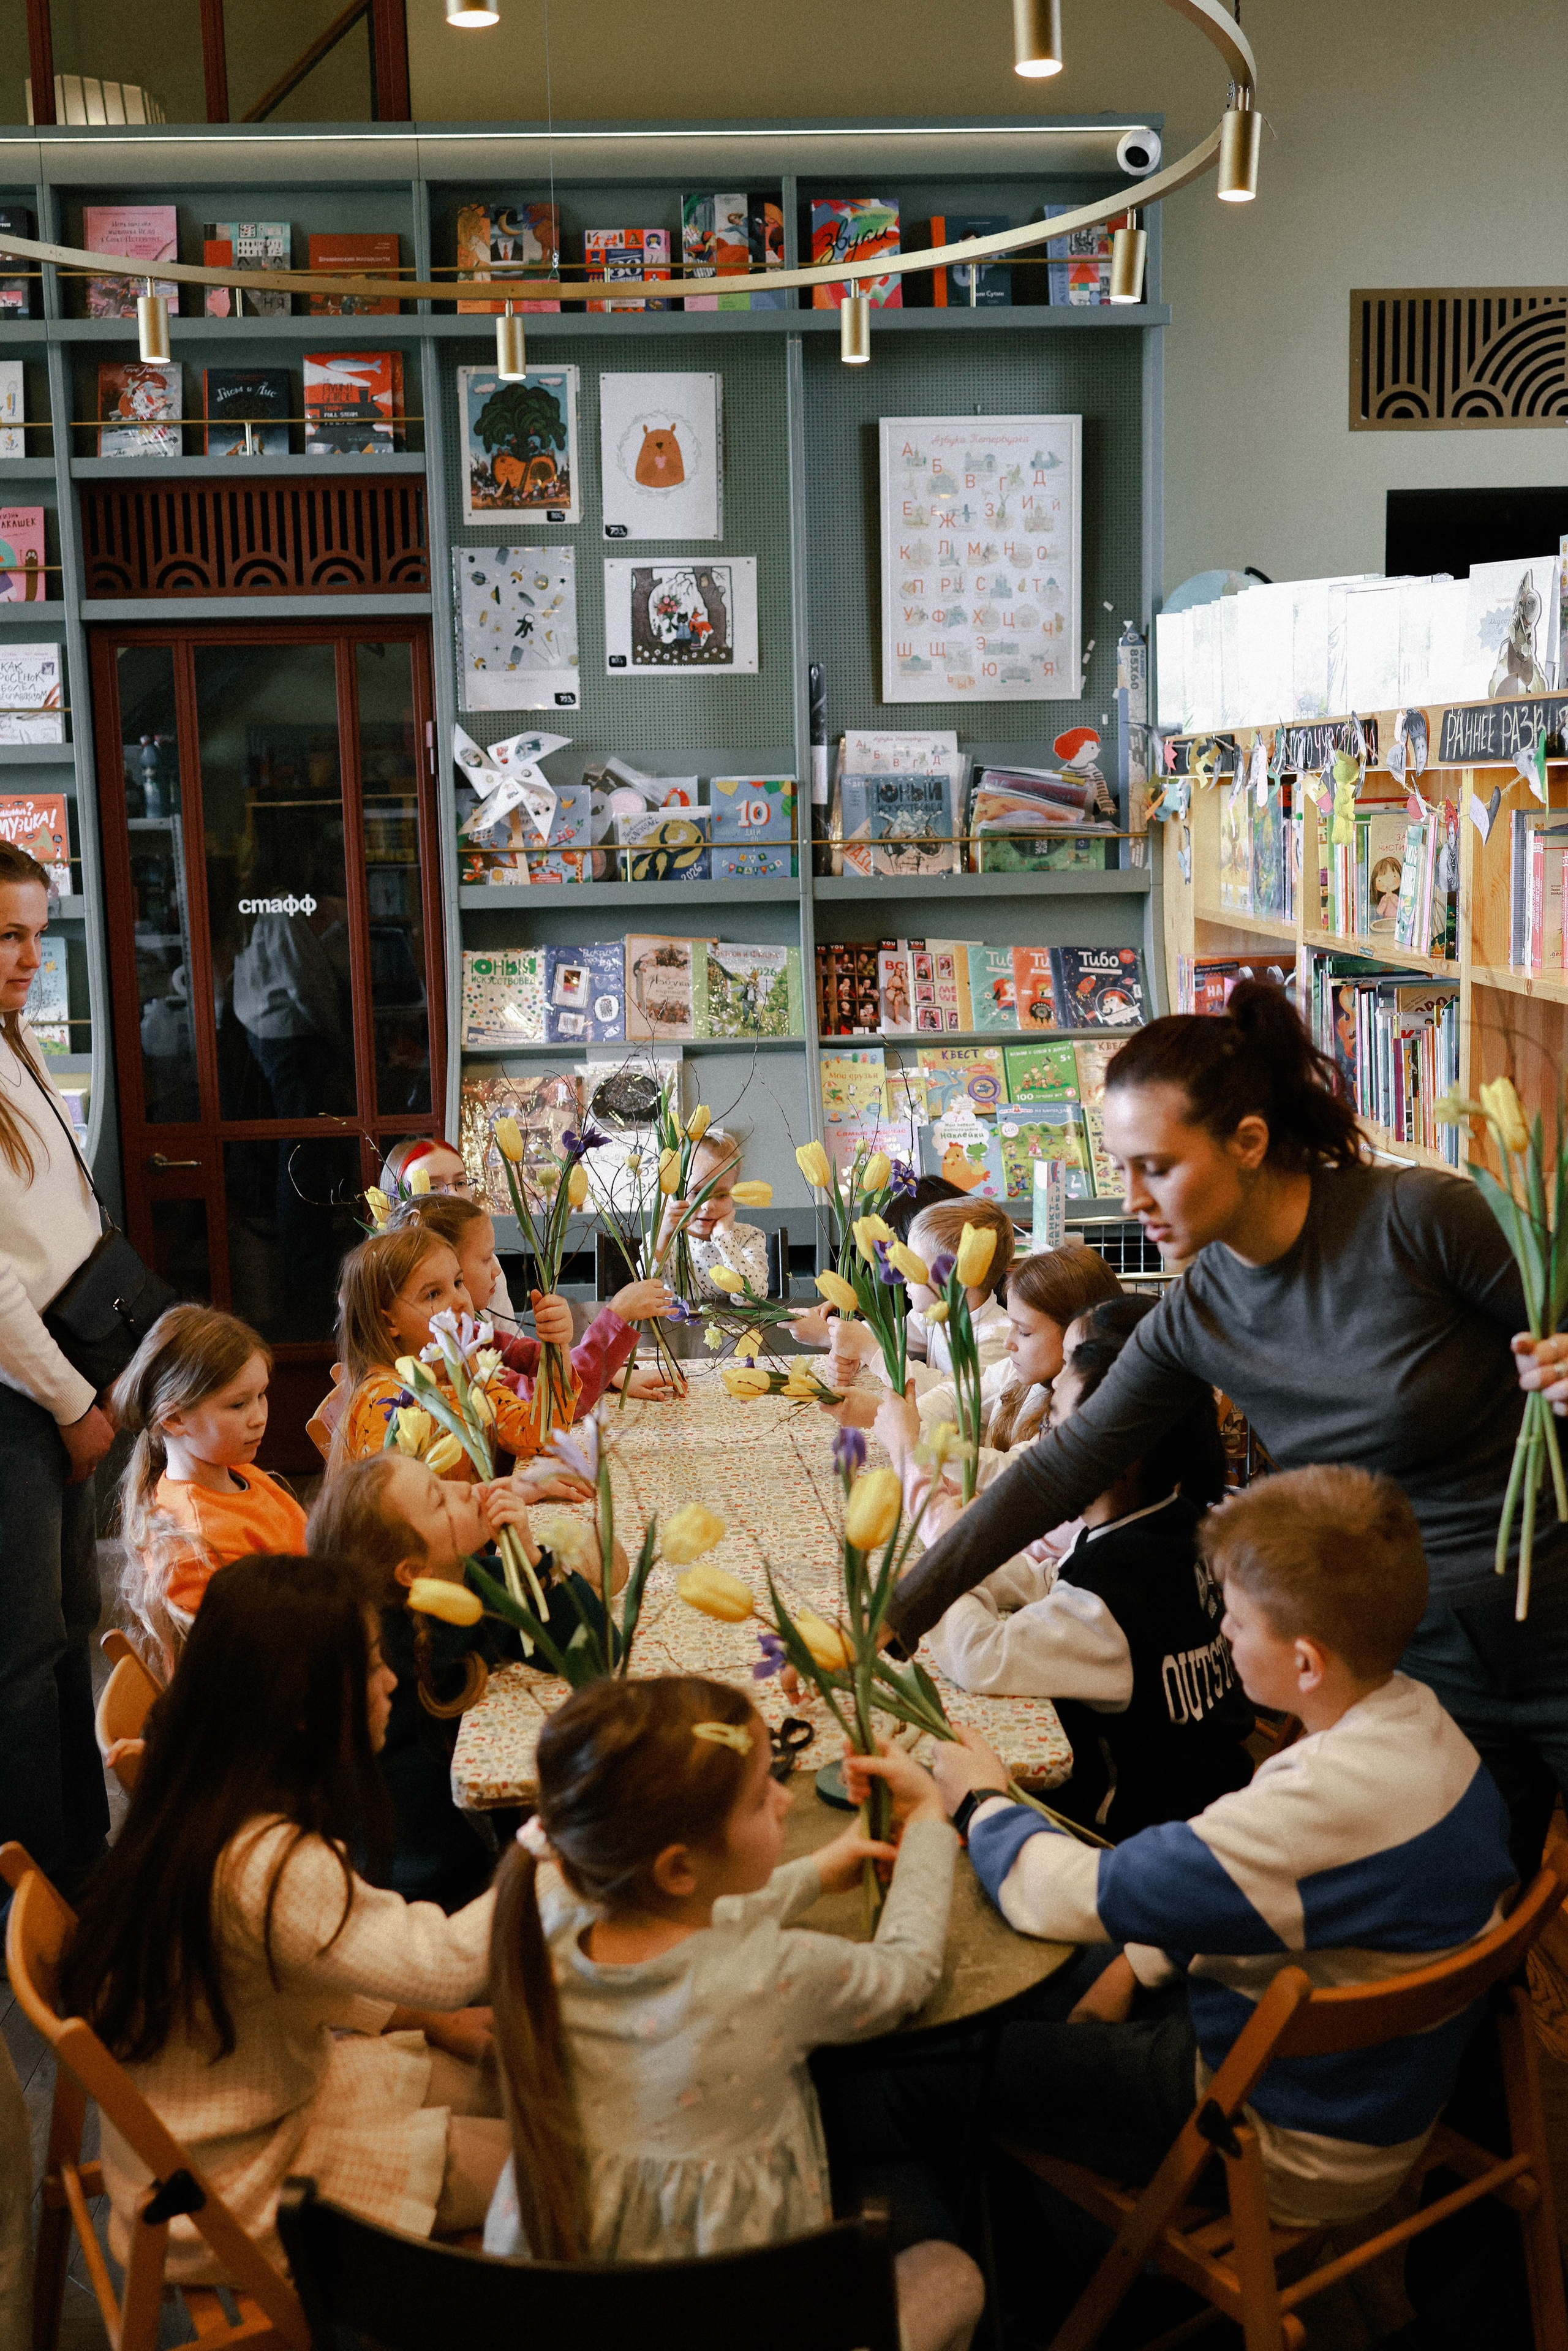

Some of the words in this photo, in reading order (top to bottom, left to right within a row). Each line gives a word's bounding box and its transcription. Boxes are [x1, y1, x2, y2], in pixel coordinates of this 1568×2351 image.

[902, 442, 913, 456] А
[933, 459, 942, 473] Б
[966, 475, 975, 488] В
[1000, 477, 1006, 490] Г
[1034, 470, 1046, 486] Д
[903, 502, 912, 515] Е
[1023, 497, 1033, 508] И
[986, 504, 993, 517] З
[1, 518, 36, 529] АКАШЕК
[940, 514, 956, 527] Ж
[900, 545, 910, 559] К
[938, 541, 949, 554] Л
[968, 542, 980, 555] М
[1005, 542, 1014, 554] Н
[1038, 547, 1046, 560] О
[913, 579, 923, 593] П
[941, 579, 950, 592] Р
[977, 577, 986, 591] С
[1033, 579, 1041, 592] Т
[903, 606, 913, 620] У
[932, 611, 945, 622] Ф
[973, 609, 983, 623] Х
[1003, 613, 1014, 627] Ц
[1043, 624, 1052, 635] Ч
[897, 643, 911, 657] Ш
[930, 643, 945, 657] Щ
[977, 637, 986, 650] Э
[983, 663, 997, 676] Ю
[1044, 663, 1054, 675] Я
[1446, 708, 1496, 760] РАННЕЕ
[736, 800, 771, 828] 10
[238, 893, 317, 918] стафф
[986, 950, 1013, 967] Тиб
[1030, 952, 1051, 967] Ти
[1078, 951, 1120, 967] Тибо
[941, 1048, 979, 1060] КВЕСТ
[845, 1142, 902, 1153] НАЛЕЙКИ
